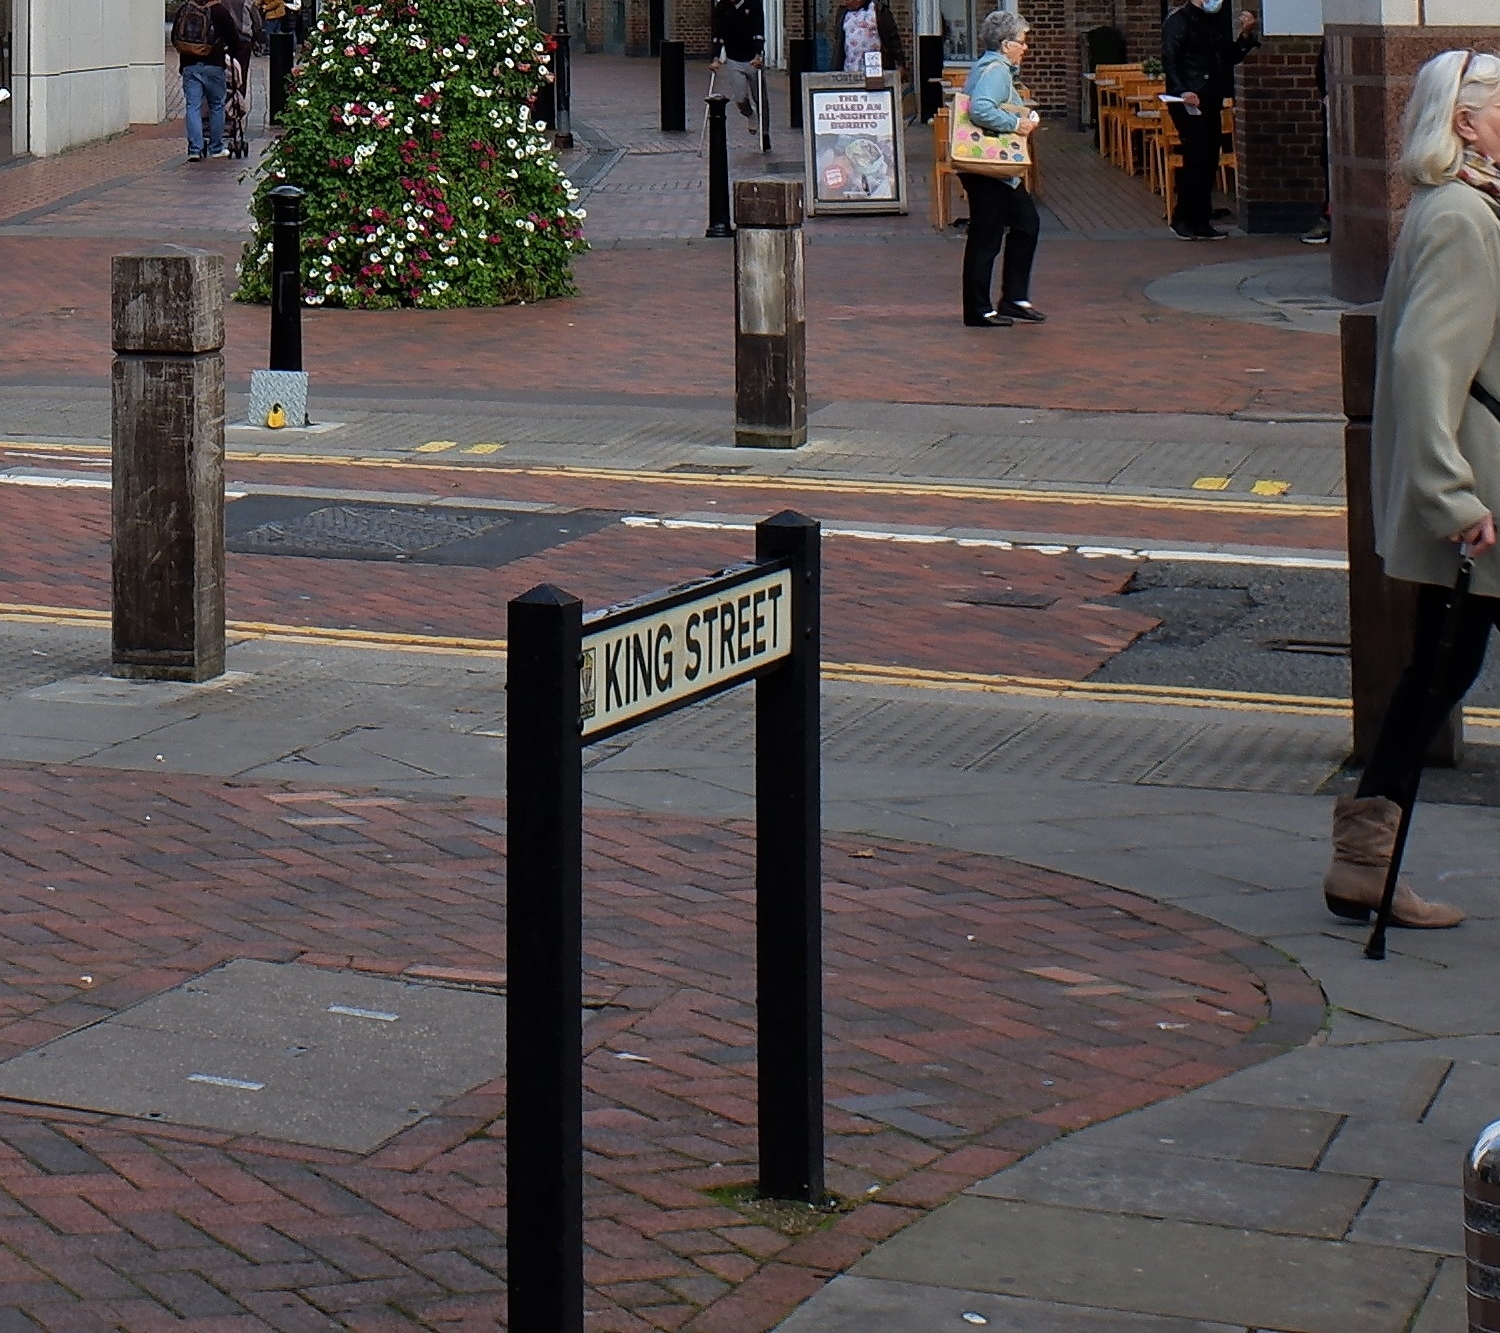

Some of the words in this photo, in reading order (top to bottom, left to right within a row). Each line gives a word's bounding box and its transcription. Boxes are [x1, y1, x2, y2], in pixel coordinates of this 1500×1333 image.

[831, 122, 878, 130] BURRITO
[605, 623, 674, 713] KING
[684, 583, 783, 682] STREET
